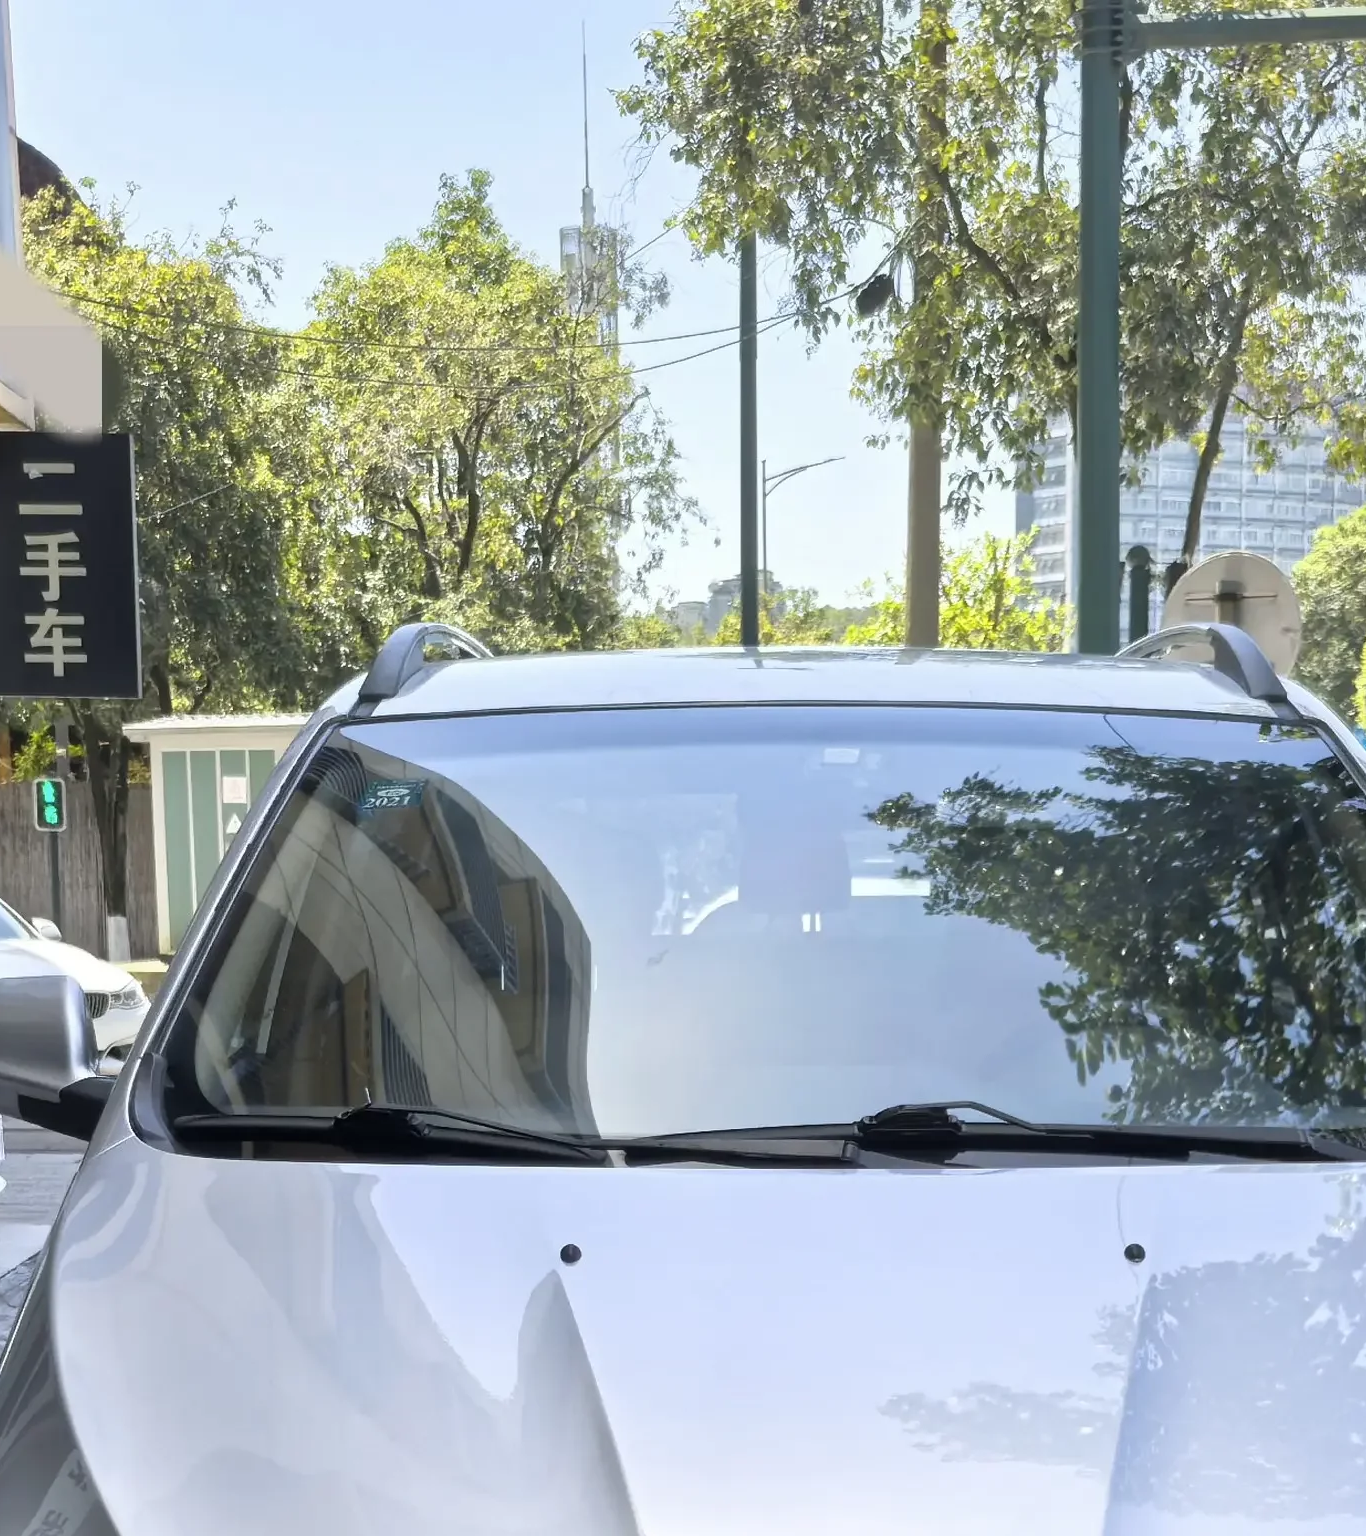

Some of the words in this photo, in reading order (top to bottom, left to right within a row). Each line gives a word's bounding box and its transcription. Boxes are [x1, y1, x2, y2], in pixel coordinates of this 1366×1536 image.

[18, 462, 87, 677] 二手车
[362, 796, 411, 809] 2021
